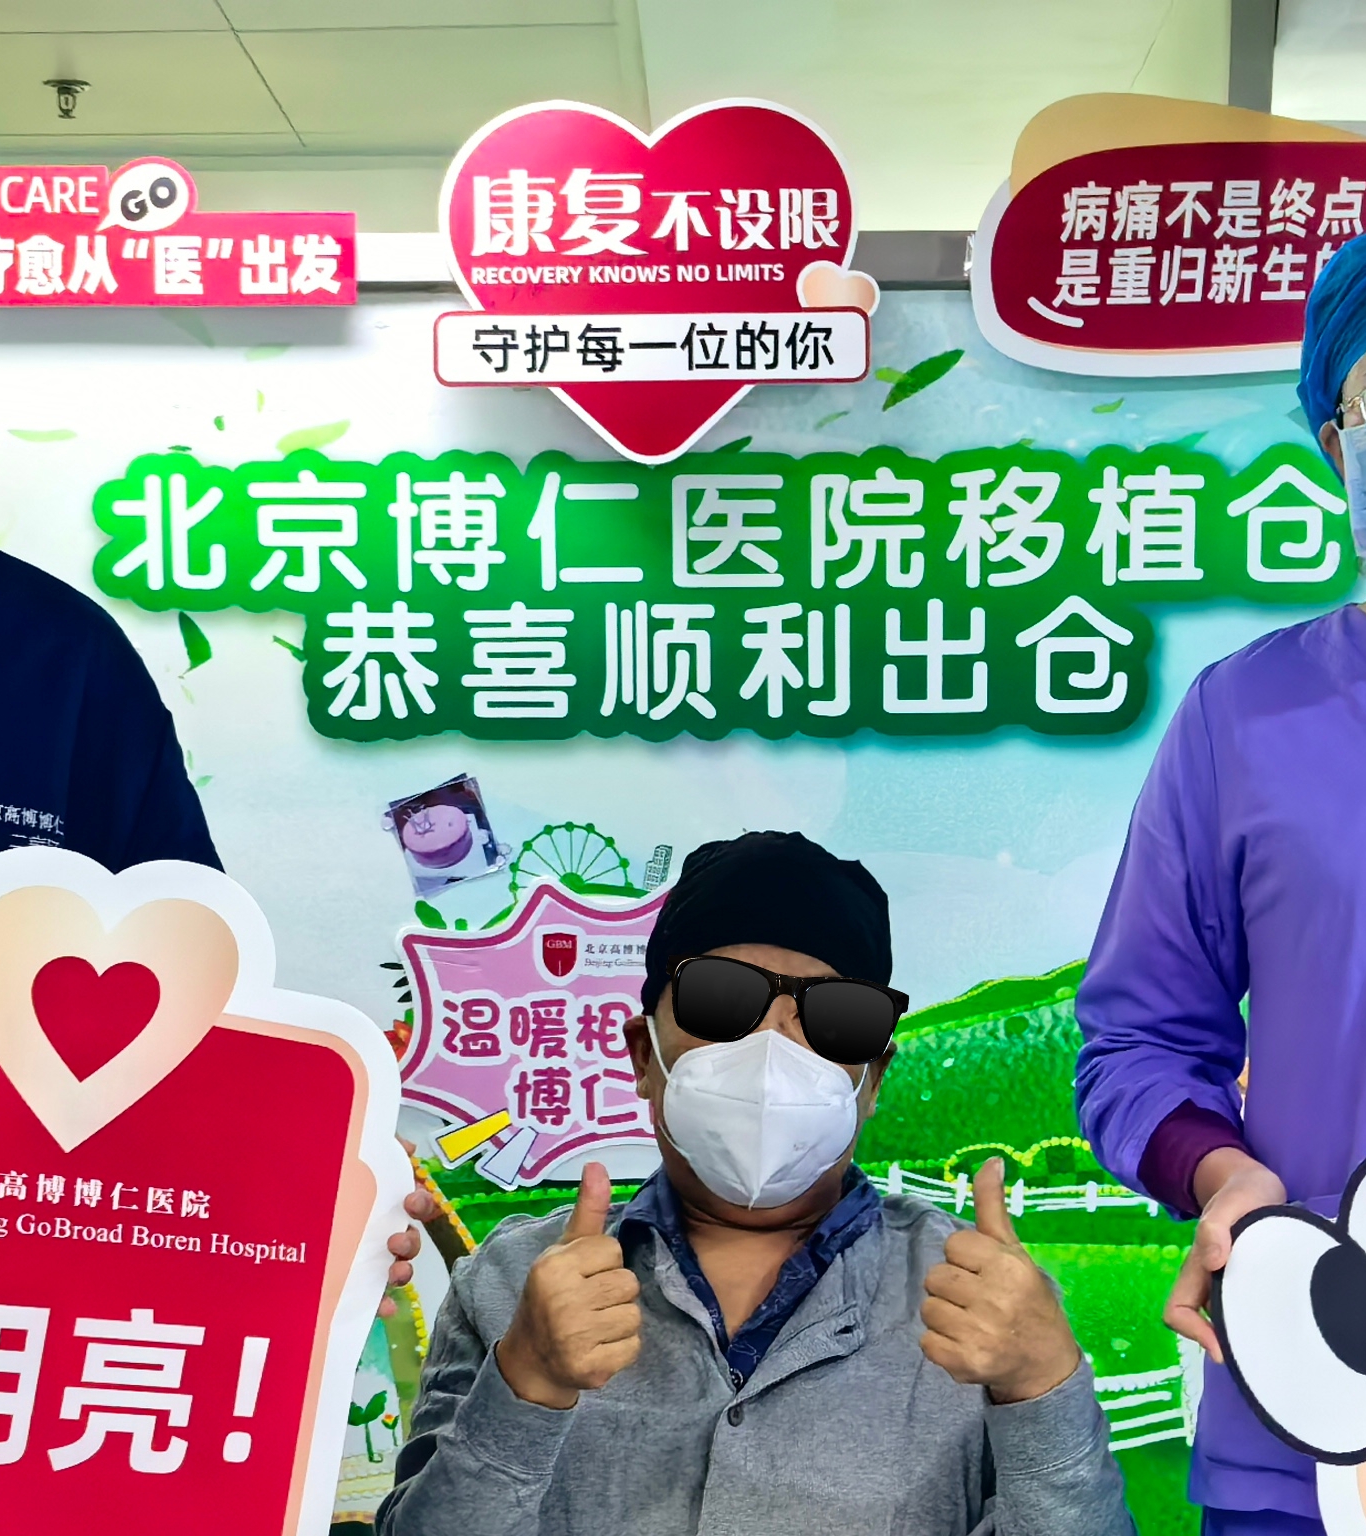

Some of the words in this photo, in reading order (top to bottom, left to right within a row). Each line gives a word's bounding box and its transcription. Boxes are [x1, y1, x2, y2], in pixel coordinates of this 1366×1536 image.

[0, 176, 100, 213] CARE
[120, 176, 177, 221] GO
[471, 168, 840, 256] 康复不设限
[1060, 176, 1366, 243] 病痛不是终点
[471, 266, 584, 285] RECOVERY
[588, 265, 671, 283] KNOWS
[676, 264, 710, 282] NO
[716, 262, 784, 282] LIMITS
[472, 322, 834, 374] 守护每一位的你
[112, 463, 1347, 593] 北京博仁医院移植仓
[322, 595, 1134, 720] 恭喜顺利出仓
[546, 939, 573, 950] GBM
[514, 1066, 638, 1127] 博仁
[16, 1213, 123, 1244] GoBroad
[132, 1225, 201, 1253] Boren
[210, 1233, 307, 1265] Hospital
